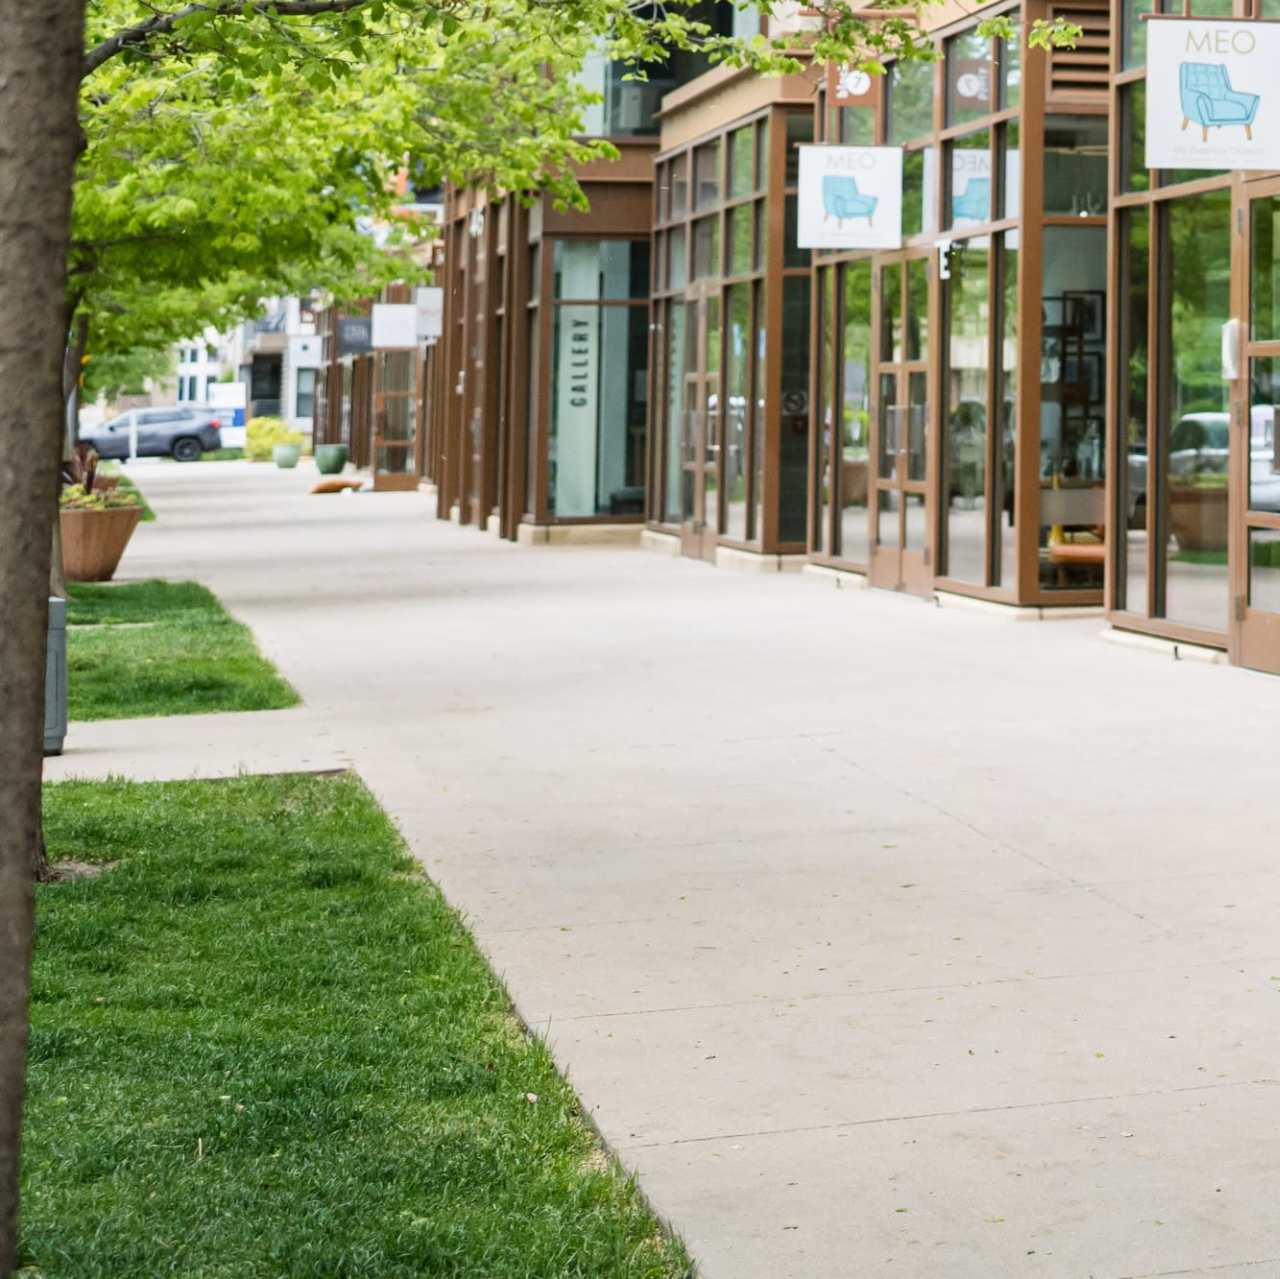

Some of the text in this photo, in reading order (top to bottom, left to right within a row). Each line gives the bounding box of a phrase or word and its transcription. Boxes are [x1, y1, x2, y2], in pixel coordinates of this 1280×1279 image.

[1185, 29, 1256, 54] MEO
[826, 152, 877, 170] MEO
[570, 319, 589, 408] GALLERY
